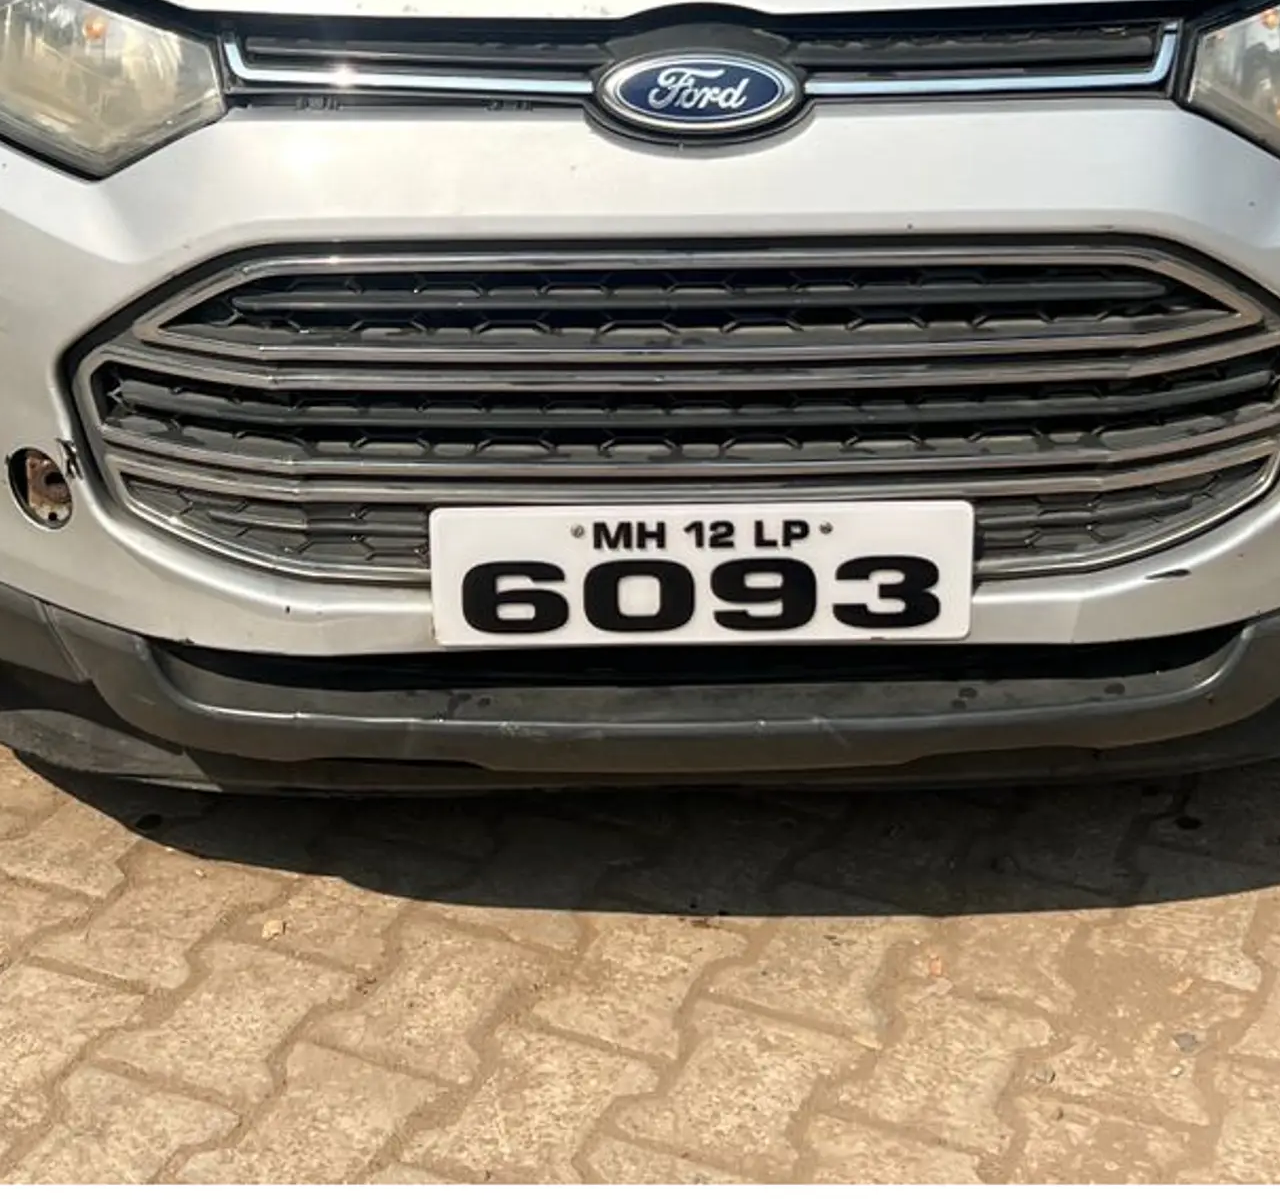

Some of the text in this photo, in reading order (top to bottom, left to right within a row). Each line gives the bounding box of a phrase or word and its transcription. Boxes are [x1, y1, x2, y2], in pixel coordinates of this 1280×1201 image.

[648, 67, 750, 109] Ford
[593, 520, 810, 549] MH 12 LP
[461, 555, 941, 635] 6093
